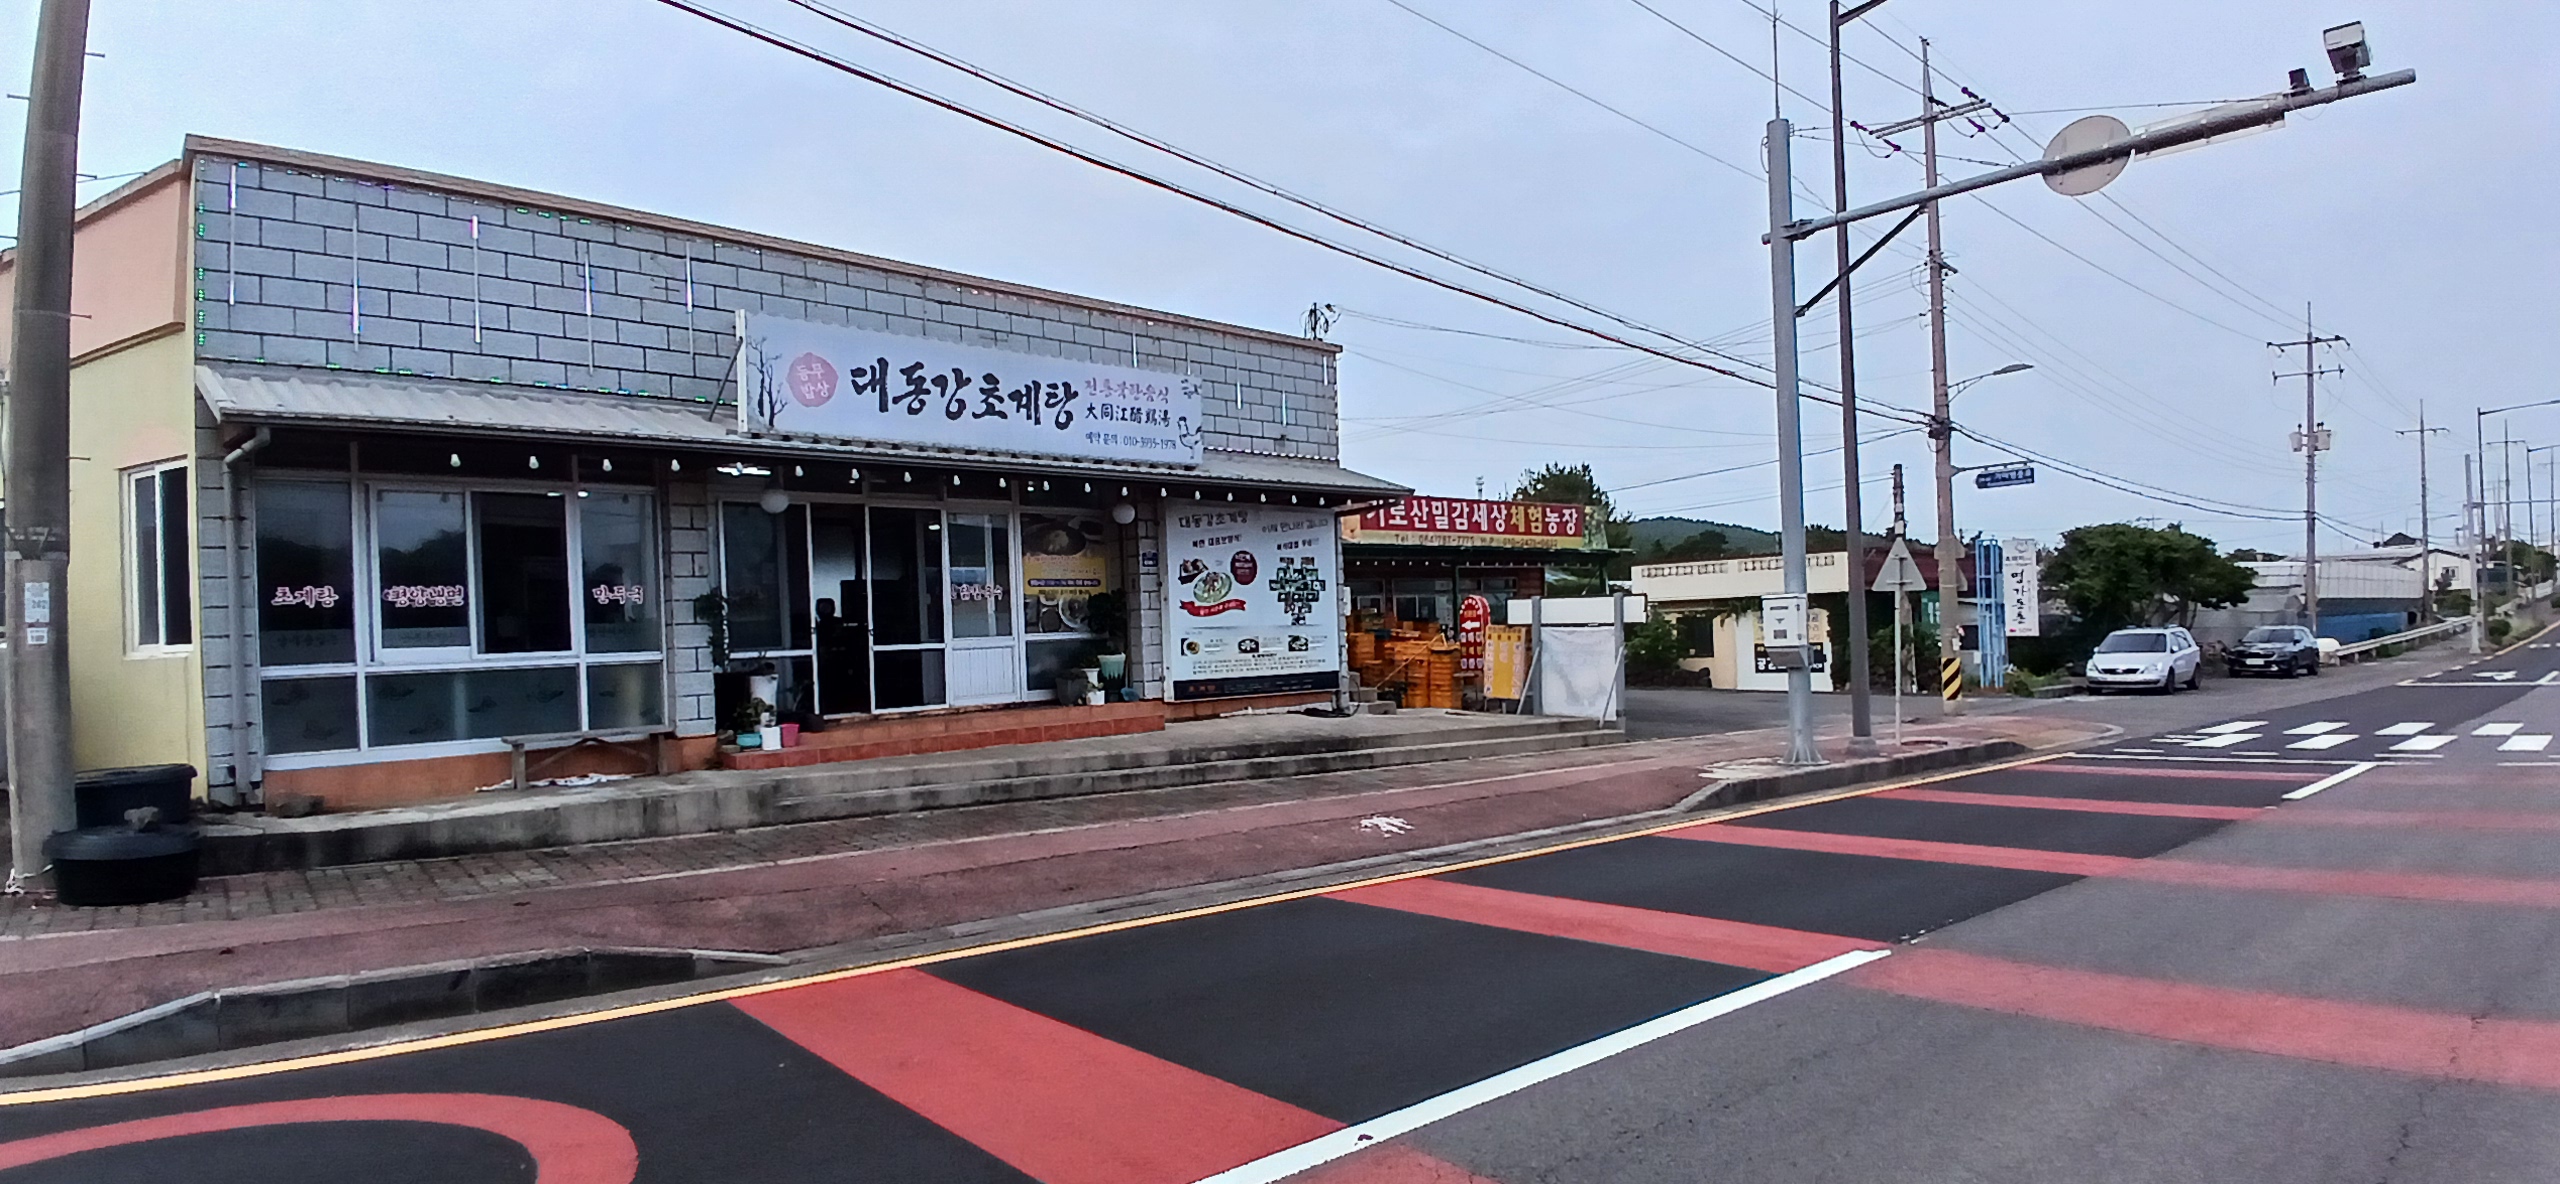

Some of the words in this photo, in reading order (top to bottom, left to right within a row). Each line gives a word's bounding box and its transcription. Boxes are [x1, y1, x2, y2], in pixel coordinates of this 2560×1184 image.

[797, 363, 825, 381] 동무
[800, 380, 830, 399] 밥상
[850, 357, 1079, 431] 대동강초계탕
[271, 585, 339, 608] 초계탕
[592, 584, 643, 604] 만두국
